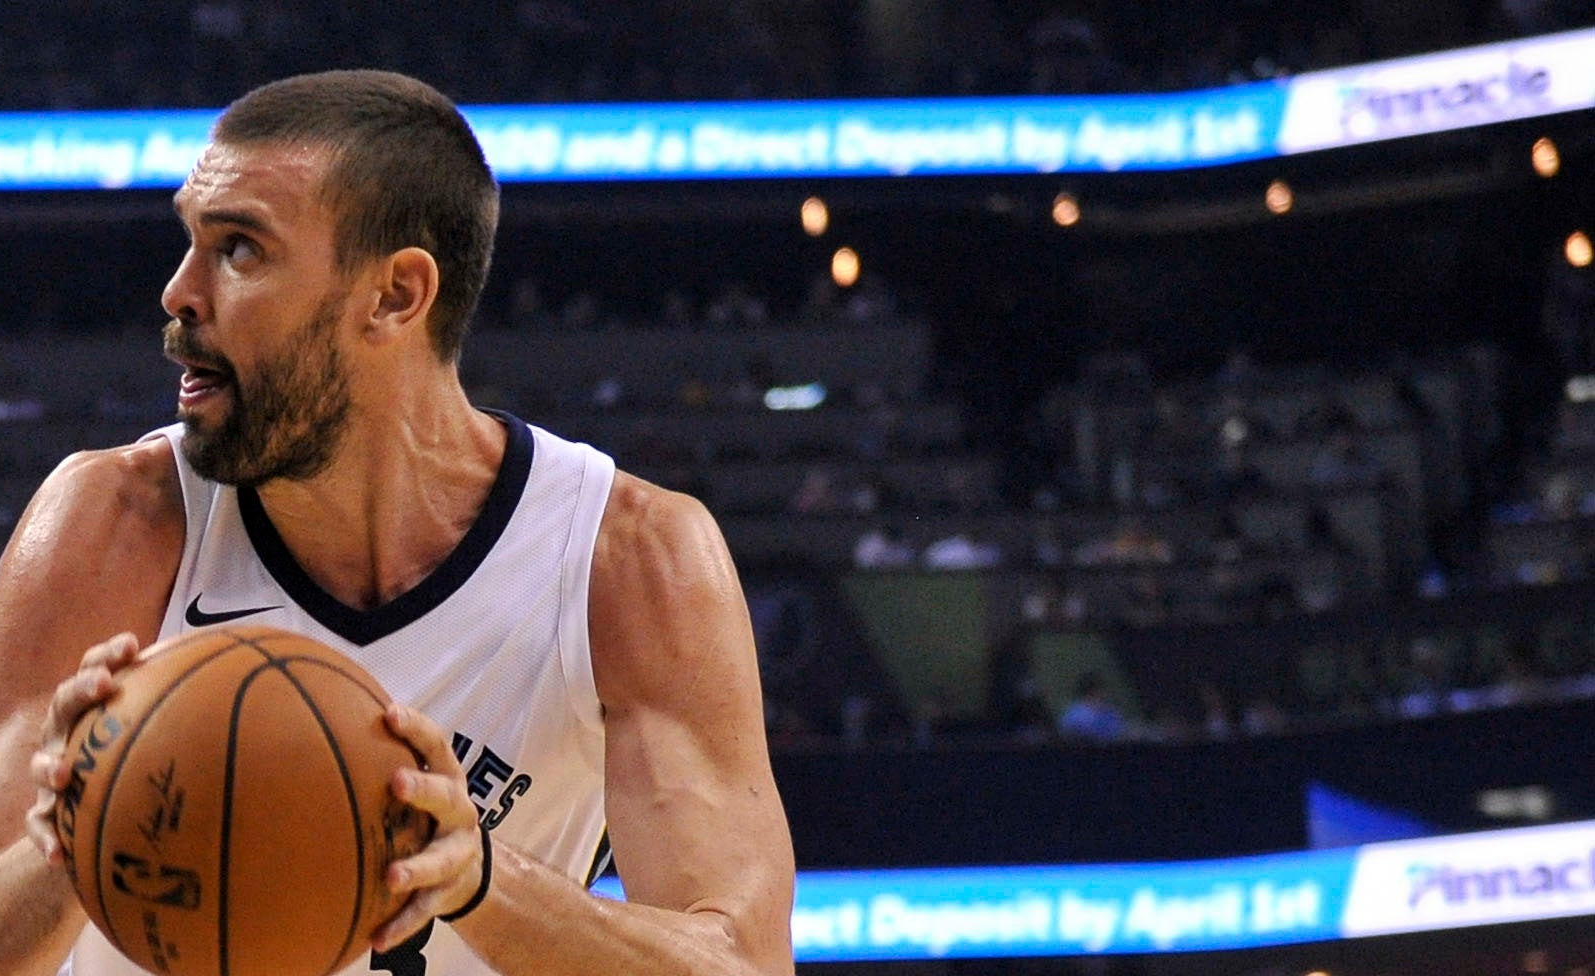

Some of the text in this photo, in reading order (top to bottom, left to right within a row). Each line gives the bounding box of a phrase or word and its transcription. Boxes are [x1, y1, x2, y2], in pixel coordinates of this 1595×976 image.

[563, 121, 653, 171] and
[691, 120, 830, 170] Direct
[835, 115, 1006, 174] Deposit
[1012, 115, 1068, 172] by
[1074, 112, 1186, 171] April
[867, 891, 1049, 955] Deposit
[1056, 889, 1120, 952] by
[1124, 883, 1242, 950] April
[1251, 879, 1322, 932] 1st
